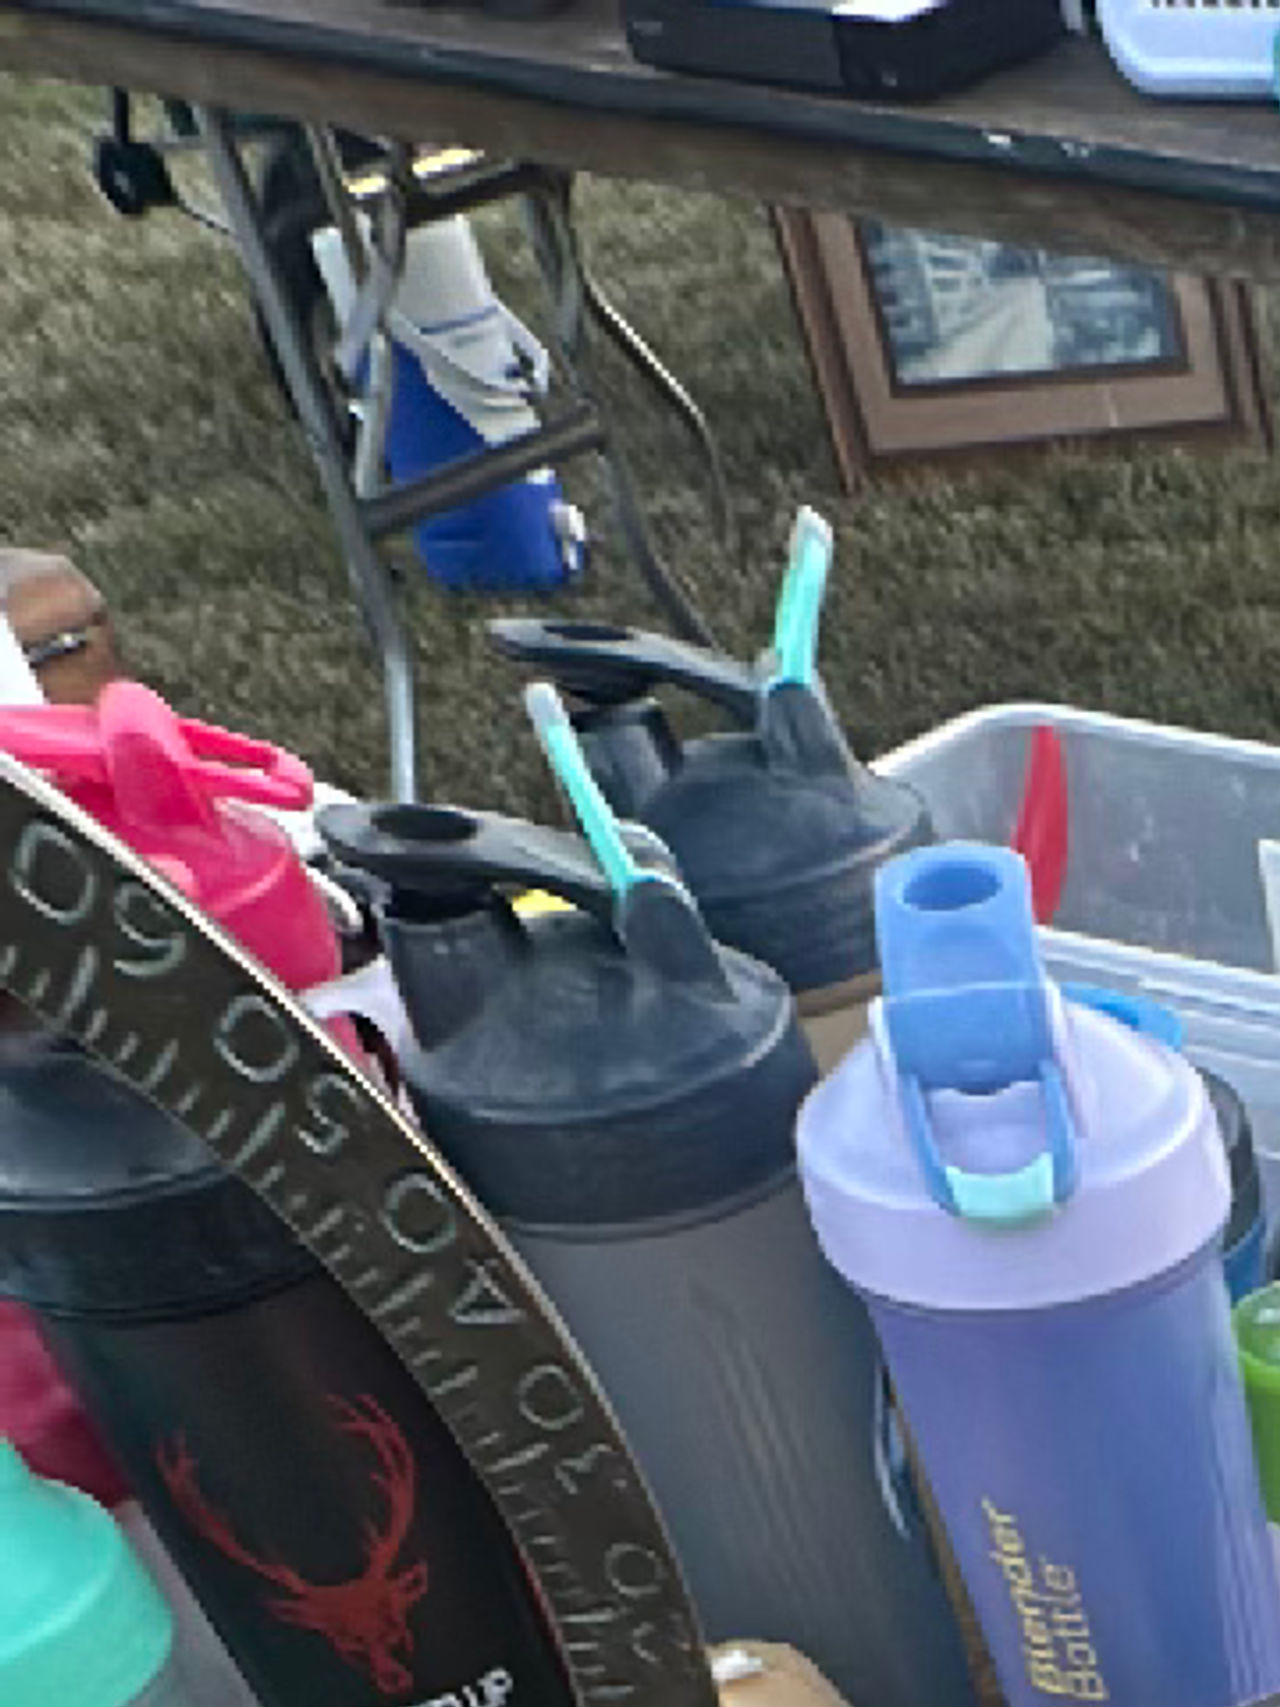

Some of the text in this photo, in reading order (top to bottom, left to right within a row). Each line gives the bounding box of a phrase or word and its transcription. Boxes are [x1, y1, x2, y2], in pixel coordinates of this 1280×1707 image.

[11, 818, 187, 977] 60
[213, 995, 369, 1156] 50
[379, 1171, 528, 1326] 40
